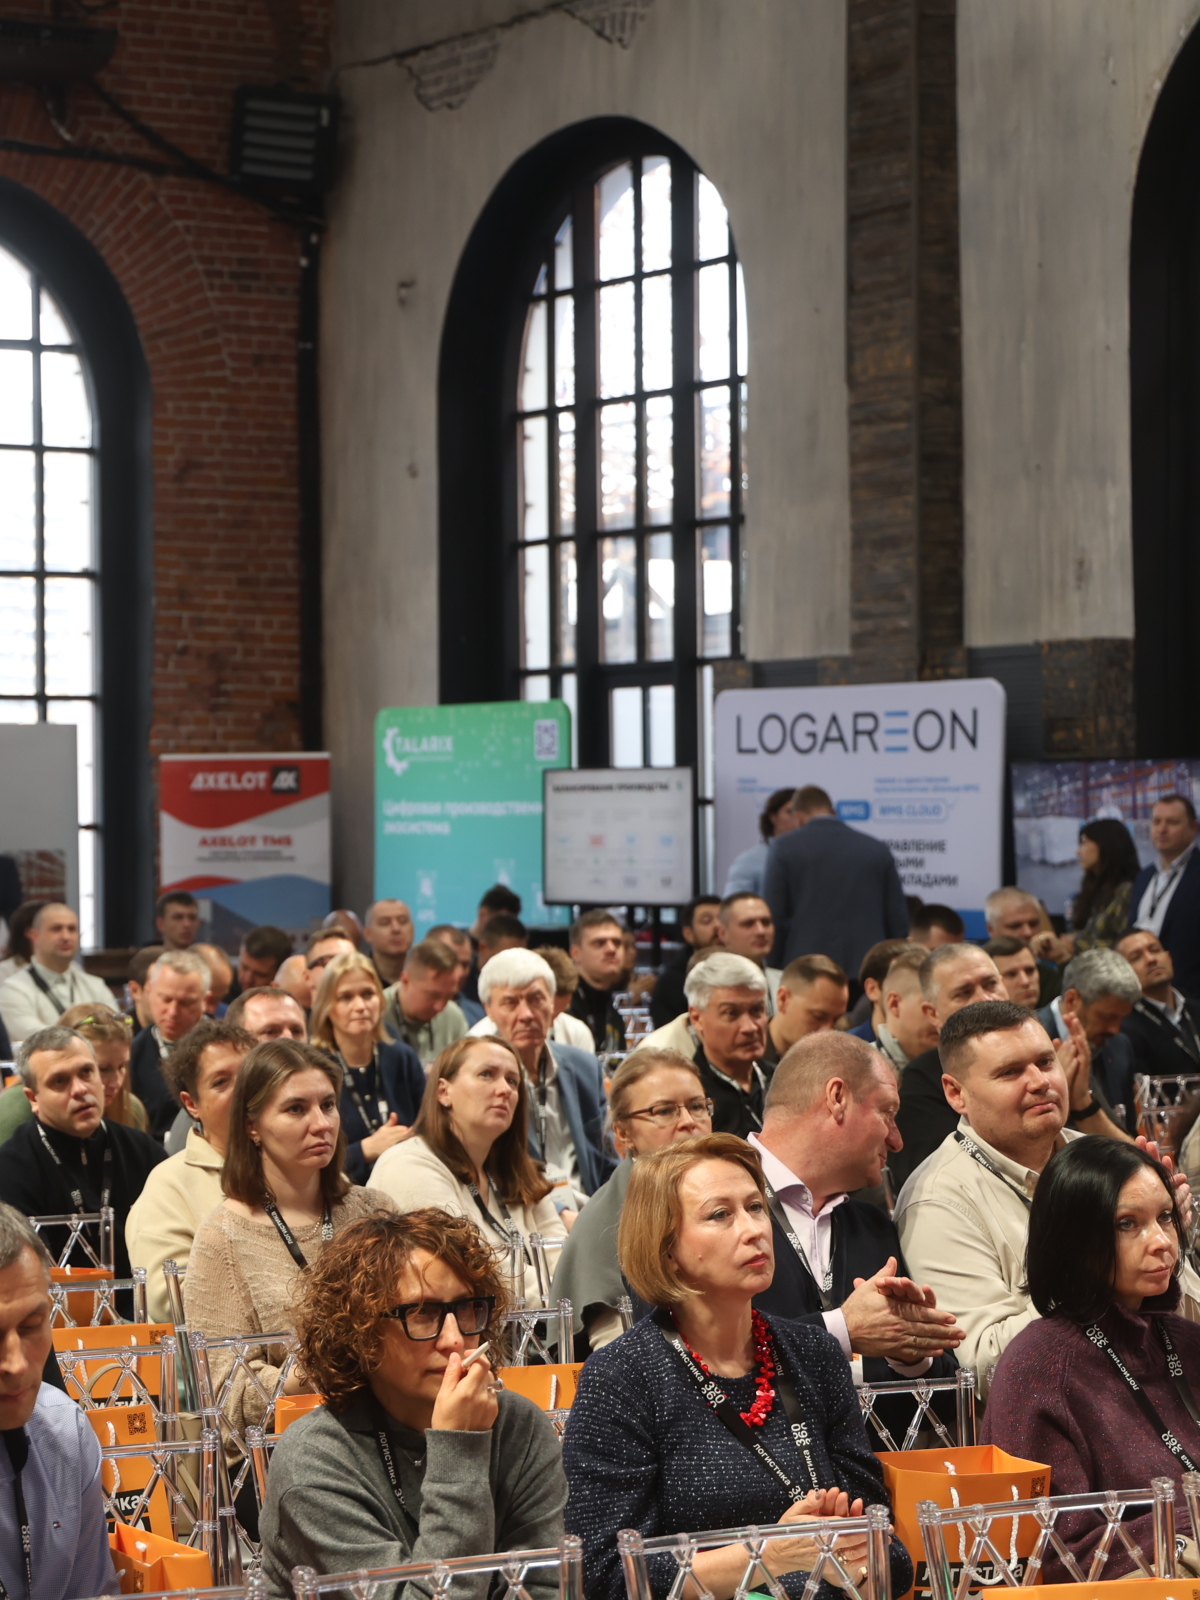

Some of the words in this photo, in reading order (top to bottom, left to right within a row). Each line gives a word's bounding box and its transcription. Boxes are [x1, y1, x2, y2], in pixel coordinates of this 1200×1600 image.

[736, 708, 978, 755] LOGAREON
[190, 771, 269, 791] AXELOT
[672, 1338, 704, 1382] логистика
[753, 1443, 791, 1486] логистика
